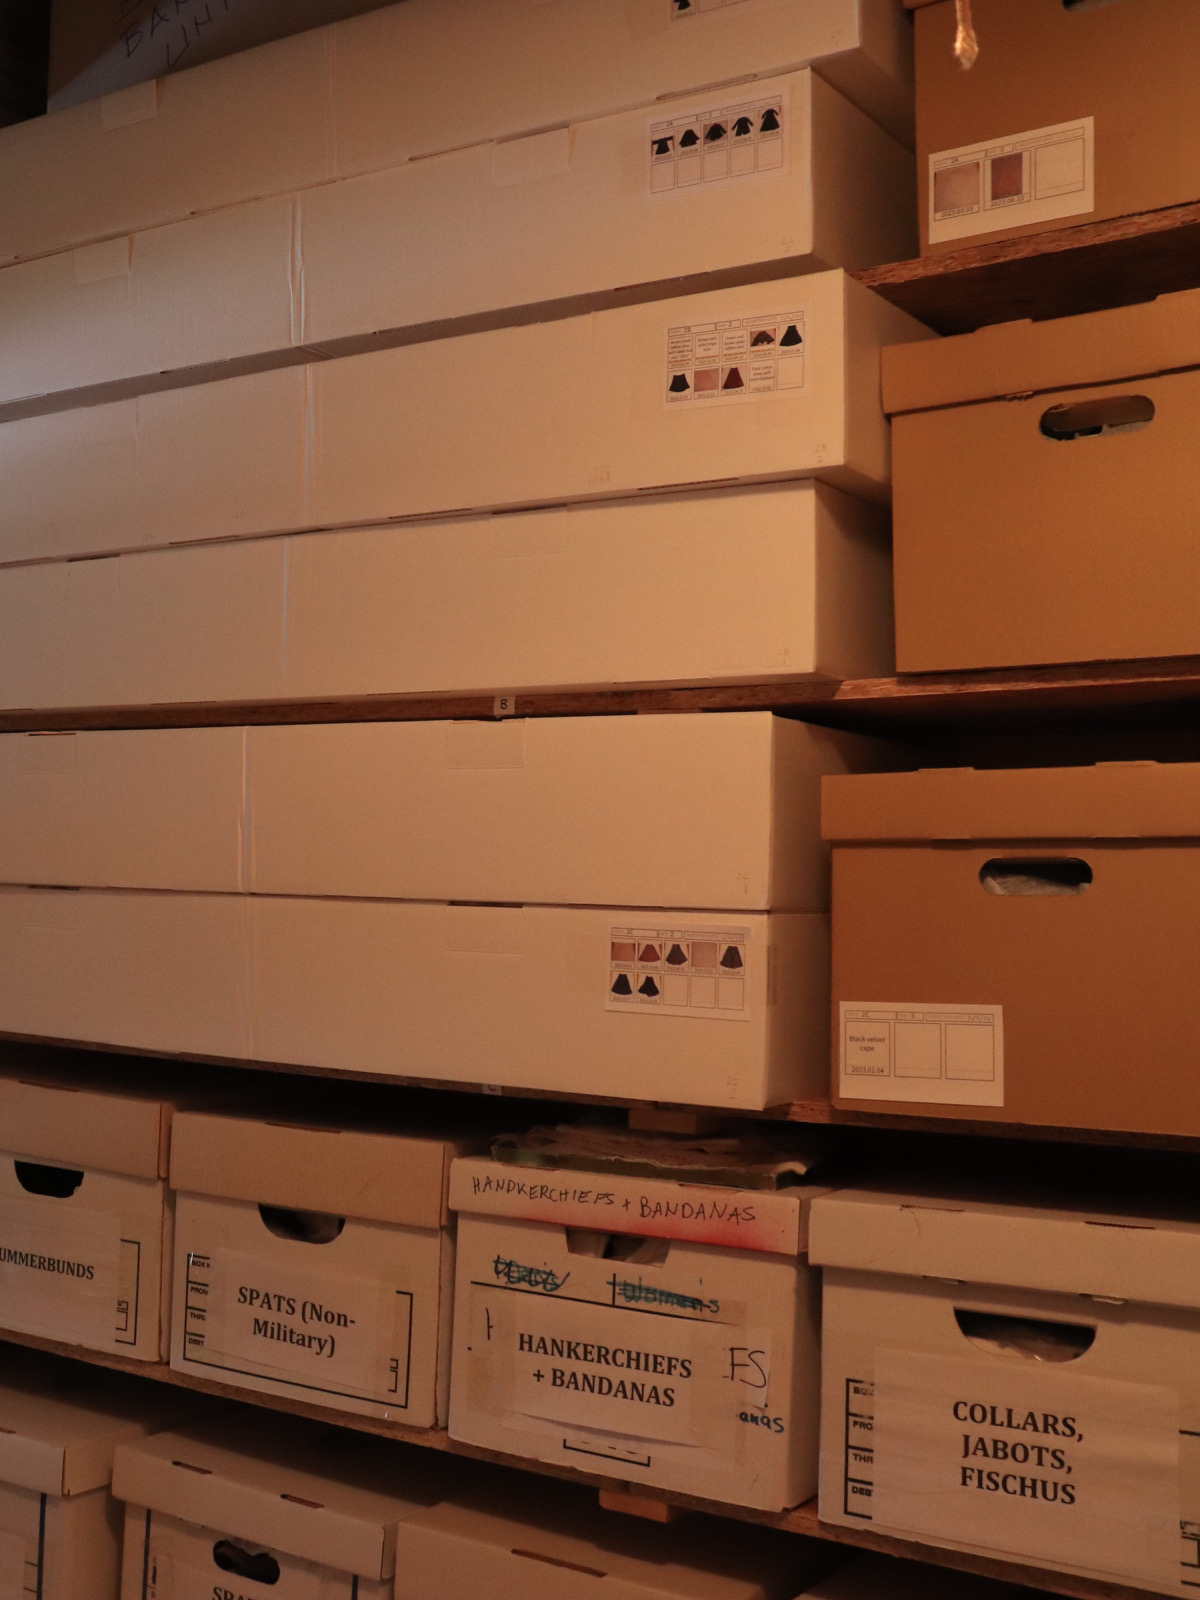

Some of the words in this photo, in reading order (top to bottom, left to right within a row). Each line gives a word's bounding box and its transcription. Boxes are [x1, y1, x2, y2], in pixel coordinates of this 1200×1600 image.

[472, 1176, 615, 1206] HANDKERCHIEFS
[639, 1196, 757, 1225] BANDANAS
[238, 1286, 296, 1316] SPATS
[300, 1300, 356, 1328] (Non-
[252, 1318, 337, 1359] Military)
[518, 1333, 692, 1379] HANKERCHIEFS
[532, 1369, 545, 1383] +
[550, 1368, 675, 1408] BANDANAS
[953, 1400, 1084, 1443] COLLARS,
[962, 1435, 1073, 1475] JABOTS,
[959, 1467, 1077, 1505] FISCHUS
